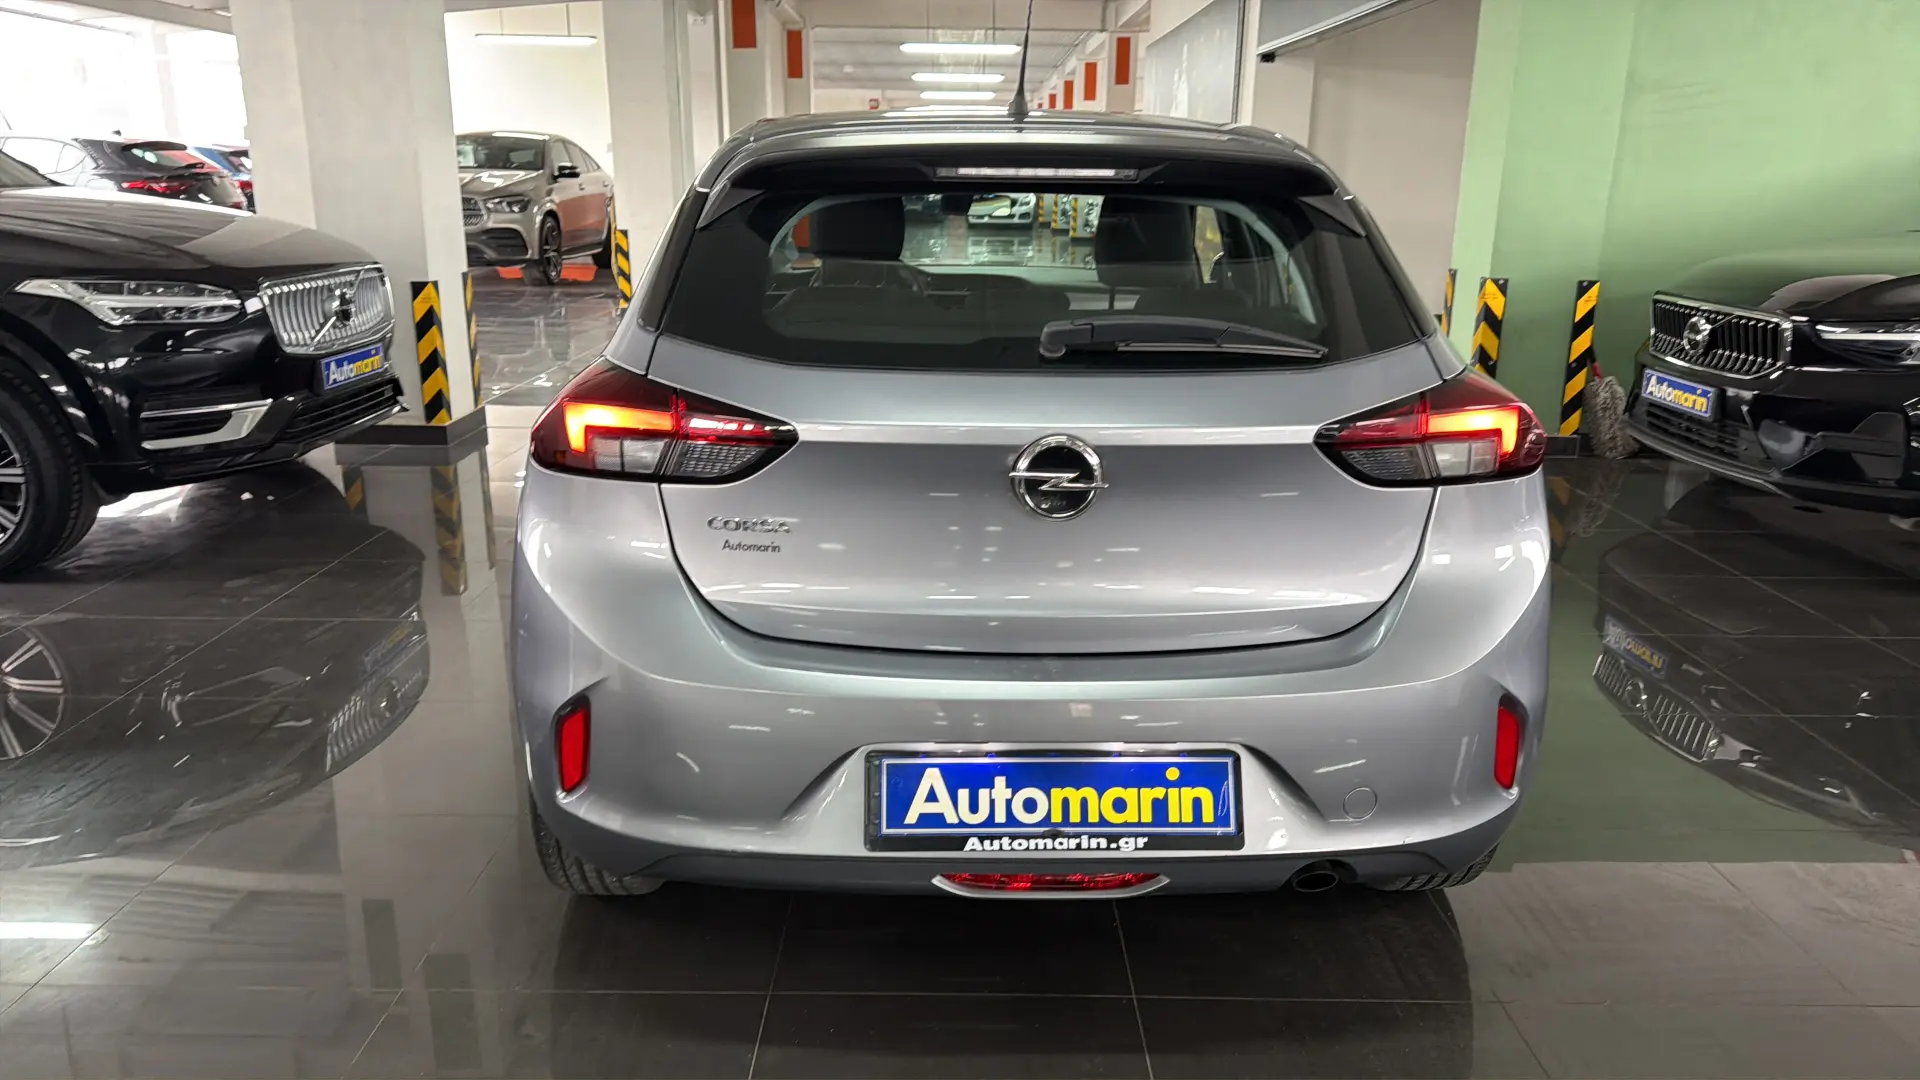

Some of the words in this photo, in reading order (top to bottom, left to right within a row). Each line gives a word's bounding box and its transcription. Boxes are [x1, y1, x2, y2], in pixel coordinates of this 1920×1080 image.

[329, 349, 382, 385] Automarin
[1646, 375, 1708, 412] Automarin
[707, 516, 791, 533] CORSA
[722, 539, 781, 552] Automarin
[904, 767, 1214, 825] Automarin
[963, 835, 1148, 852] Automarin.gr
